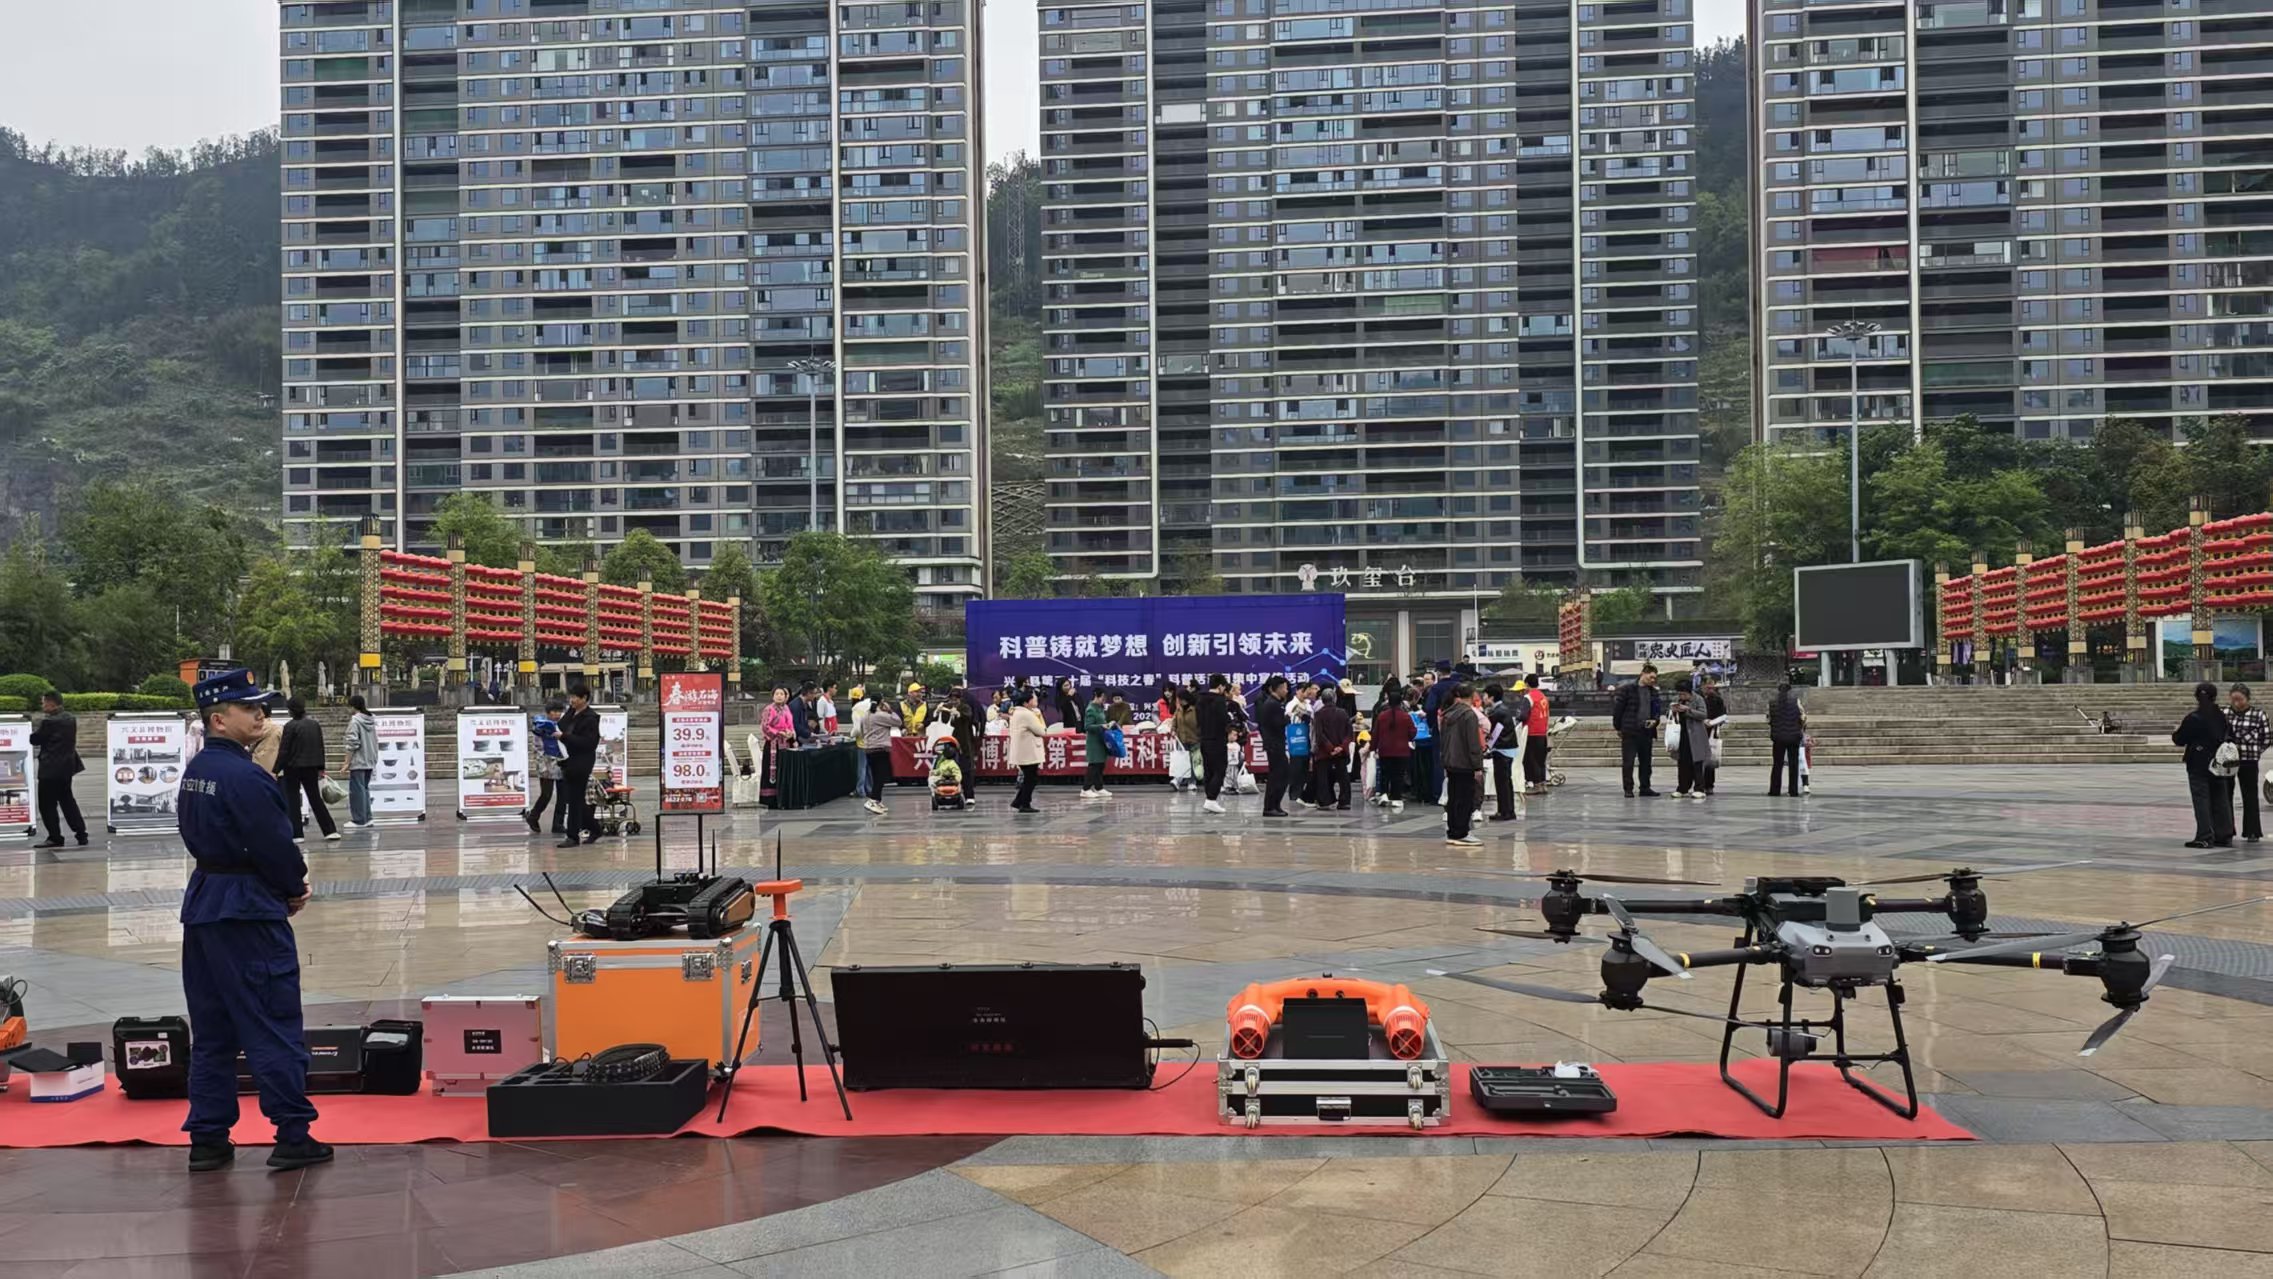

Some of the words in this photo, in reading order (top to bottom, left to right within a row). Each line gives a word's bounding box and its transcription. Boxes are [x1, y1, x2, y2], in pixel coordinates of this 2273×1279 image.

[1330, 564, 1416, 588] 玖玺台
[1000, 634, 1148, 659] 科普铸就梦想
[1163, 632, 1313, 656] 创新引领未来
[673, 728, 705, 741] 39.9
[673, 764, 705, 777] 98.0
